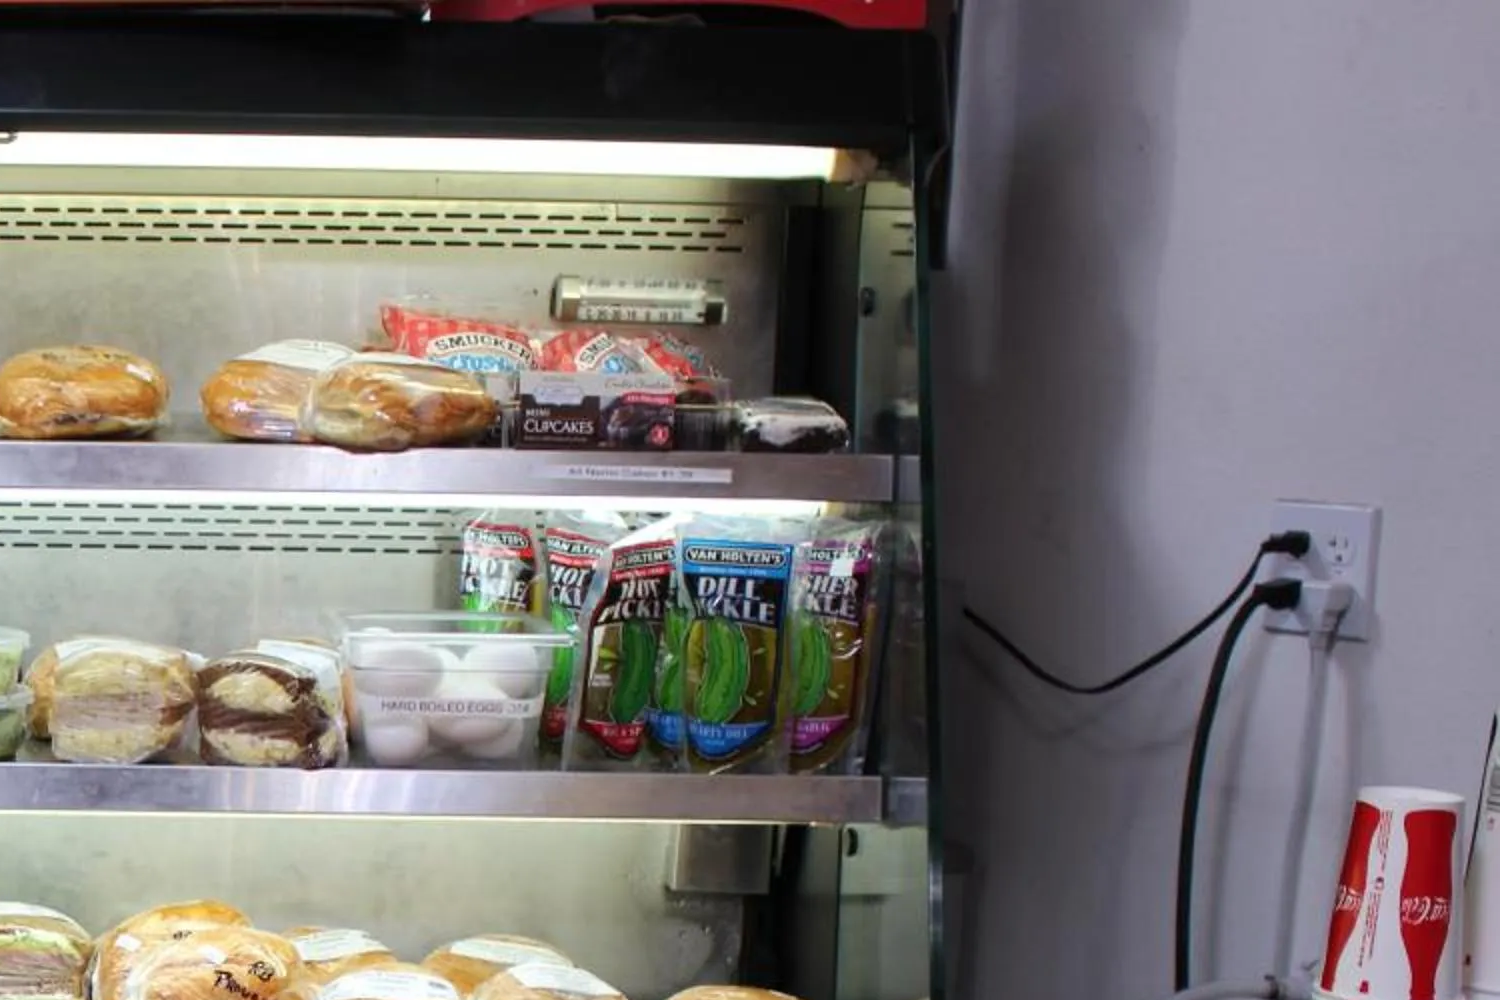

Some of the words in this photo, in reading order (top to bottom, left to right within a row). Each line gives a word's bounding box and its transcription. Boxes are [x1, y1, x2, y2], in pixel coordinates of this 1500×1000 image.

[523, 420, 595, 435] CUPCAKES
[689, 550, 717, 560] VAN
[721, 552, 781, 564] HOLTEN'S
[698, 576, 761, 601] DILL
[381, 701, 417, 712] HARD
[420, 702, 465, 713] BOILED
